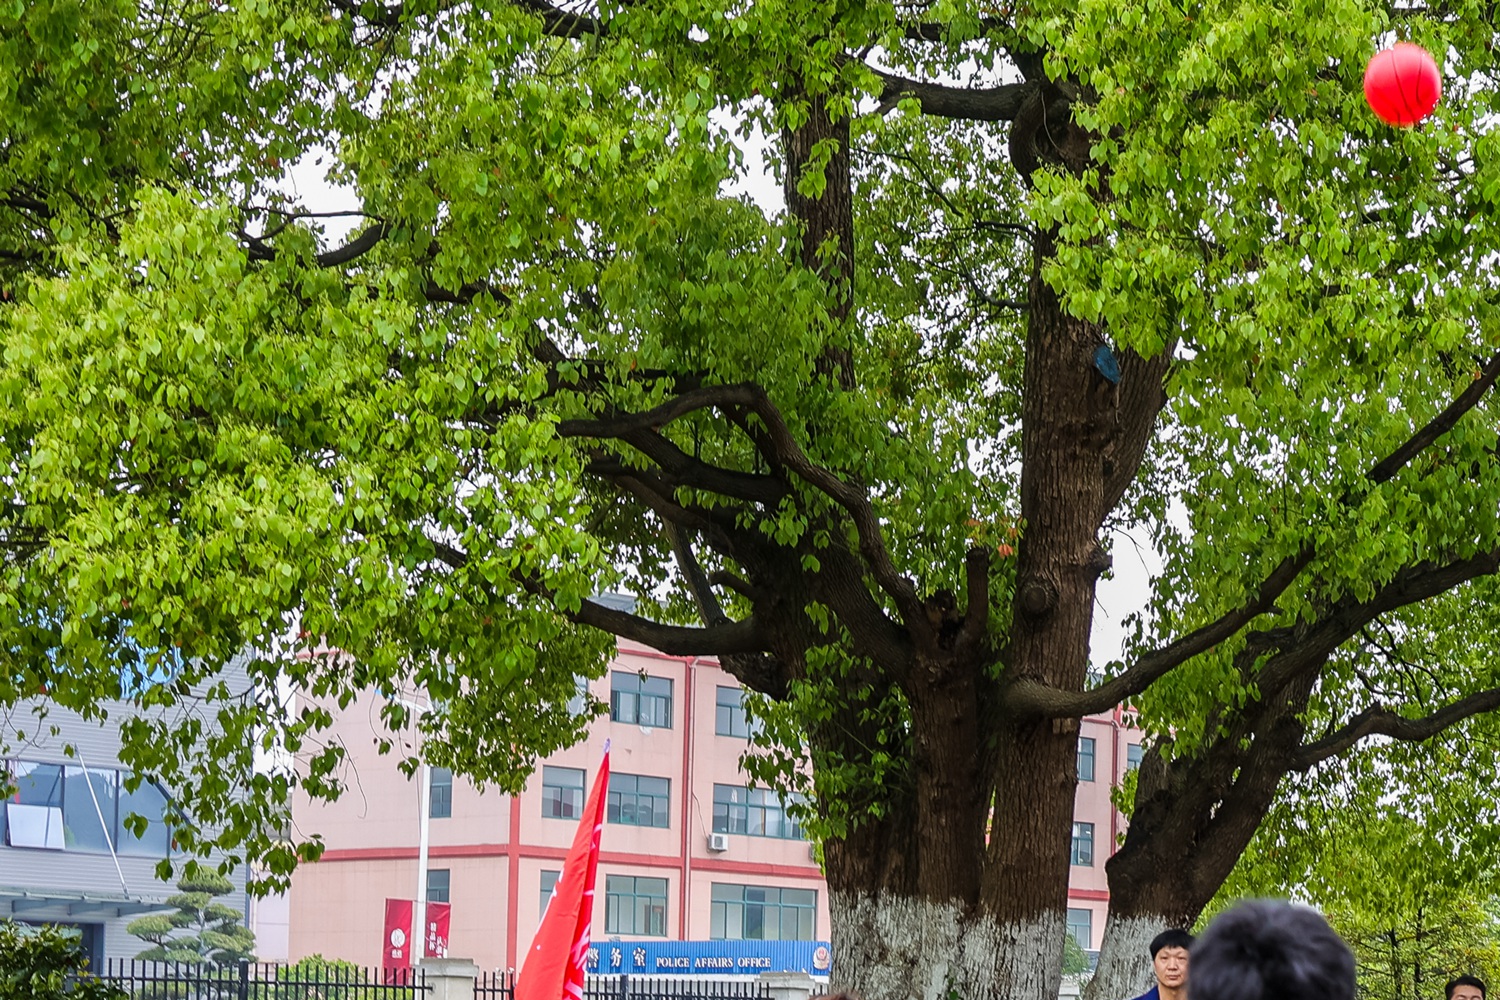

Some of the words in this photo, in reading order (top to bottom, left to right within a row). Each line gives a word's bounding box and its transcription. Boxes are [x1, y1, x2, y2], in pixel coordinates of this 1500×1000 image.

[656, 957, 690, 968] POLICE
[694, 957, 734, 968] AFFAIRS
[737, 957, 771, 968] OFFICE
